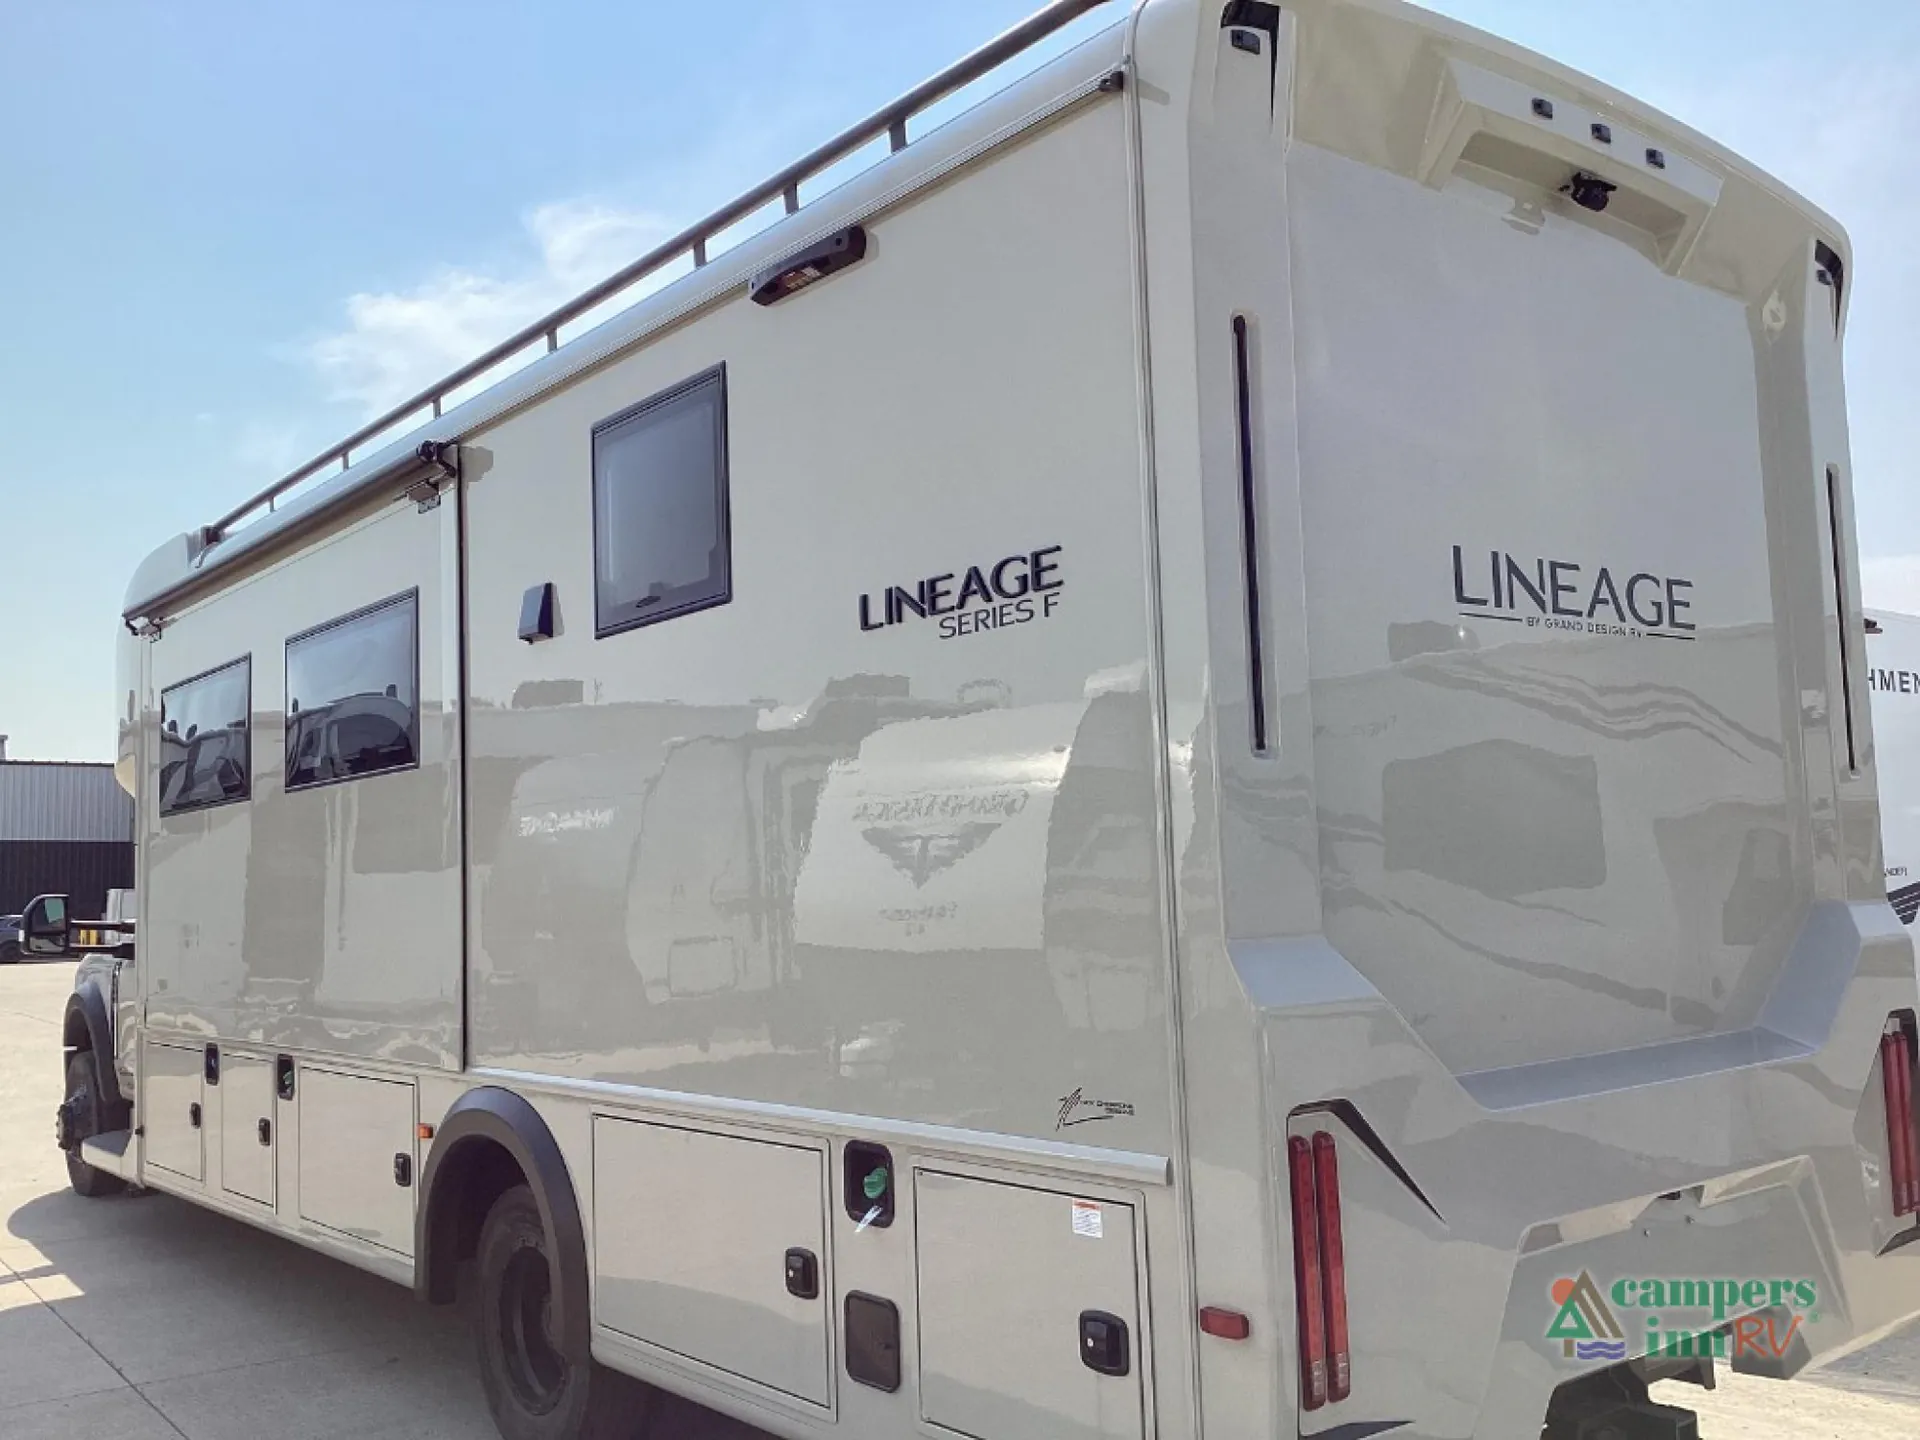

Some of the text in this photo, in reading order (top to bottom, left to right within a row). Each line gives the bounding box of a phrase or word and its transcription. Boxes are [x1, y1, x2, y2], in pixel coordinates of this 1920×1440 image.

[858, 544, 1064, 632] LINEAGE
[938, 591, 1061, 640] SERIES F
[1452, 545, 1696, 631] LINEAGE
[1527, 616, 1541, 627] BY
[1545, 618, 1583, 632] GRAND
[1587, 622, 1626, 636] DESIGN
